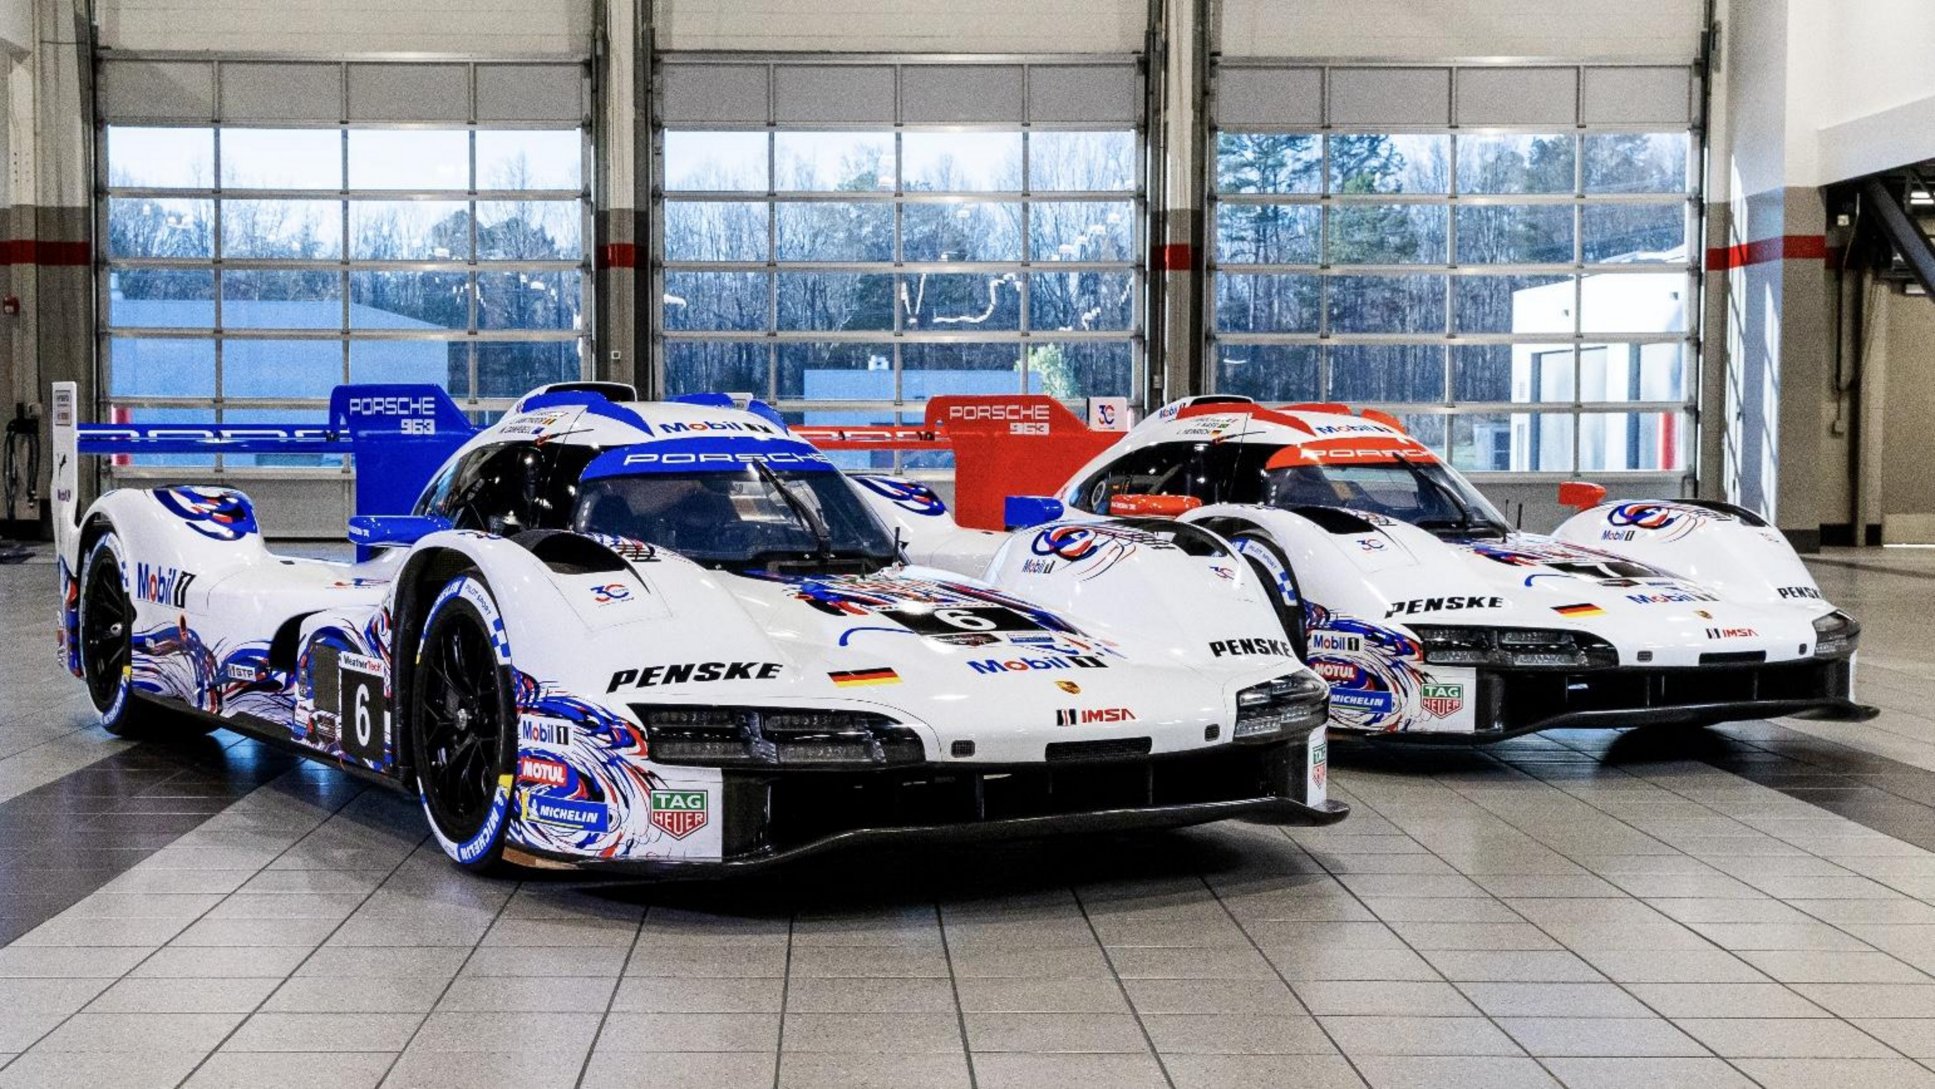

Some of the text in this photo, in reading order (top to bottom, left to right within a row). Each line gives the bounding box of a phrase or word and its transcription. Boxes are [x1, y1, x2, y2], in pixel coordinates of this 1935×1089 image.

[349, 397, 436, 416] PORSCHE
[949, 404, 1050, 420] PORSCHE
[400, 418, 436, 435] 963
[659, 421, 744, 434] Mobil
[1009, 422, 1050, 436] 963
[1315, 424, 1375, 434] Mobil
[623, 452, 829, 467] PORSCHE
[1601, 530, 1625, 541] Mobil
[1021, 559, 1045, 574] Mobil
[137, 562, 177, 606] Mobil
[476, 594, 492, 616] SPORT
[1384, 596, 1504, 619] PENSKE
[934, 609, 997, 631] 6
[1722, 628, 1759, 638] IMSA
[1208, 638, 1292, 658] PENSKE
[1313, 634, 1360, 652] Mobil 1
[236, 668, 254, 677] GTP
[966, 655, 1109, 675] Mobil 1
[1313, 663, 1355, 679] MOTUL
[605, 661, 784, 694] PENSKE
[1424, 686, 1460, 697] TAG
[1331, 694, 1384, 707] MICHELIN
[1423, 699, 1461, 715] HEUER
[355, 683, 371, 747] 6
[1081, 708, 1136, 723] IMSA
[522, 720, 569, 746] Mobil 1
[522, 761, 565, 783] MOTUL
[655, 793, 701, 809] TAG
[540, 803, 598, 824] MICHELIN
[653, 813, 704, 836] HEUER
[459, 806, 501, 861] MICHELIN
